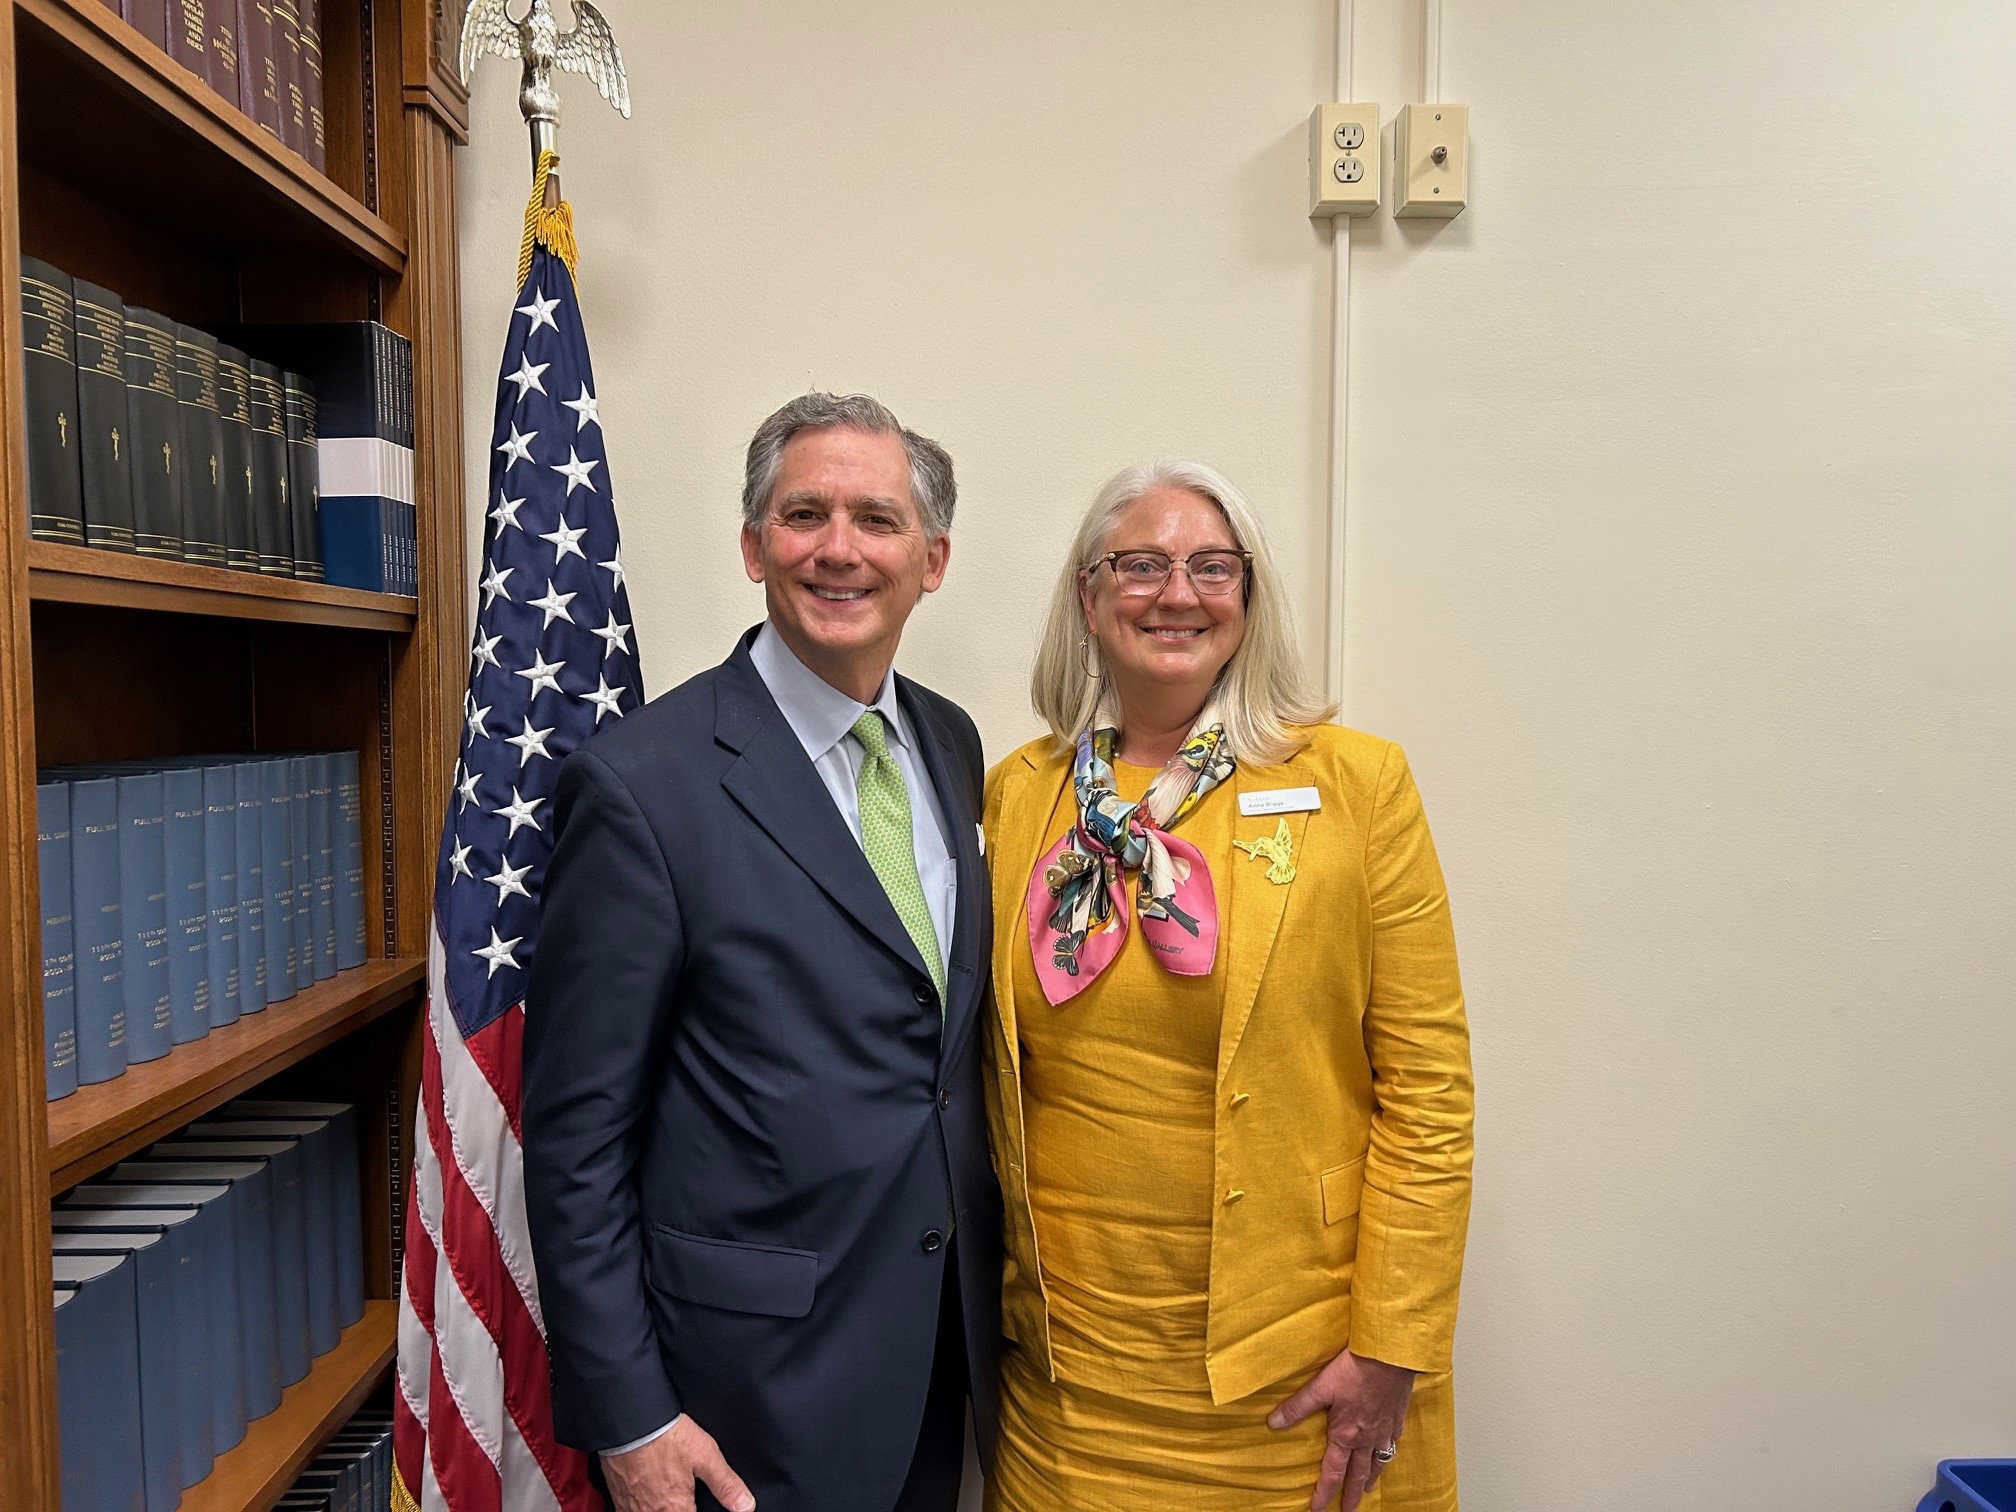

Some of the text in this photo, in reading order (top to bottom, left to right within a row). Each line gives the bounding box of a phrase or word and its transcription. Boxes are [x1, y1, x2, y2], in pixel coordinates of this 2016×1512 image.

[186, 36, 204, 53] INDEX
[133, 818, 151, 826] FULL
[86, 826, 104, 834] FULL
